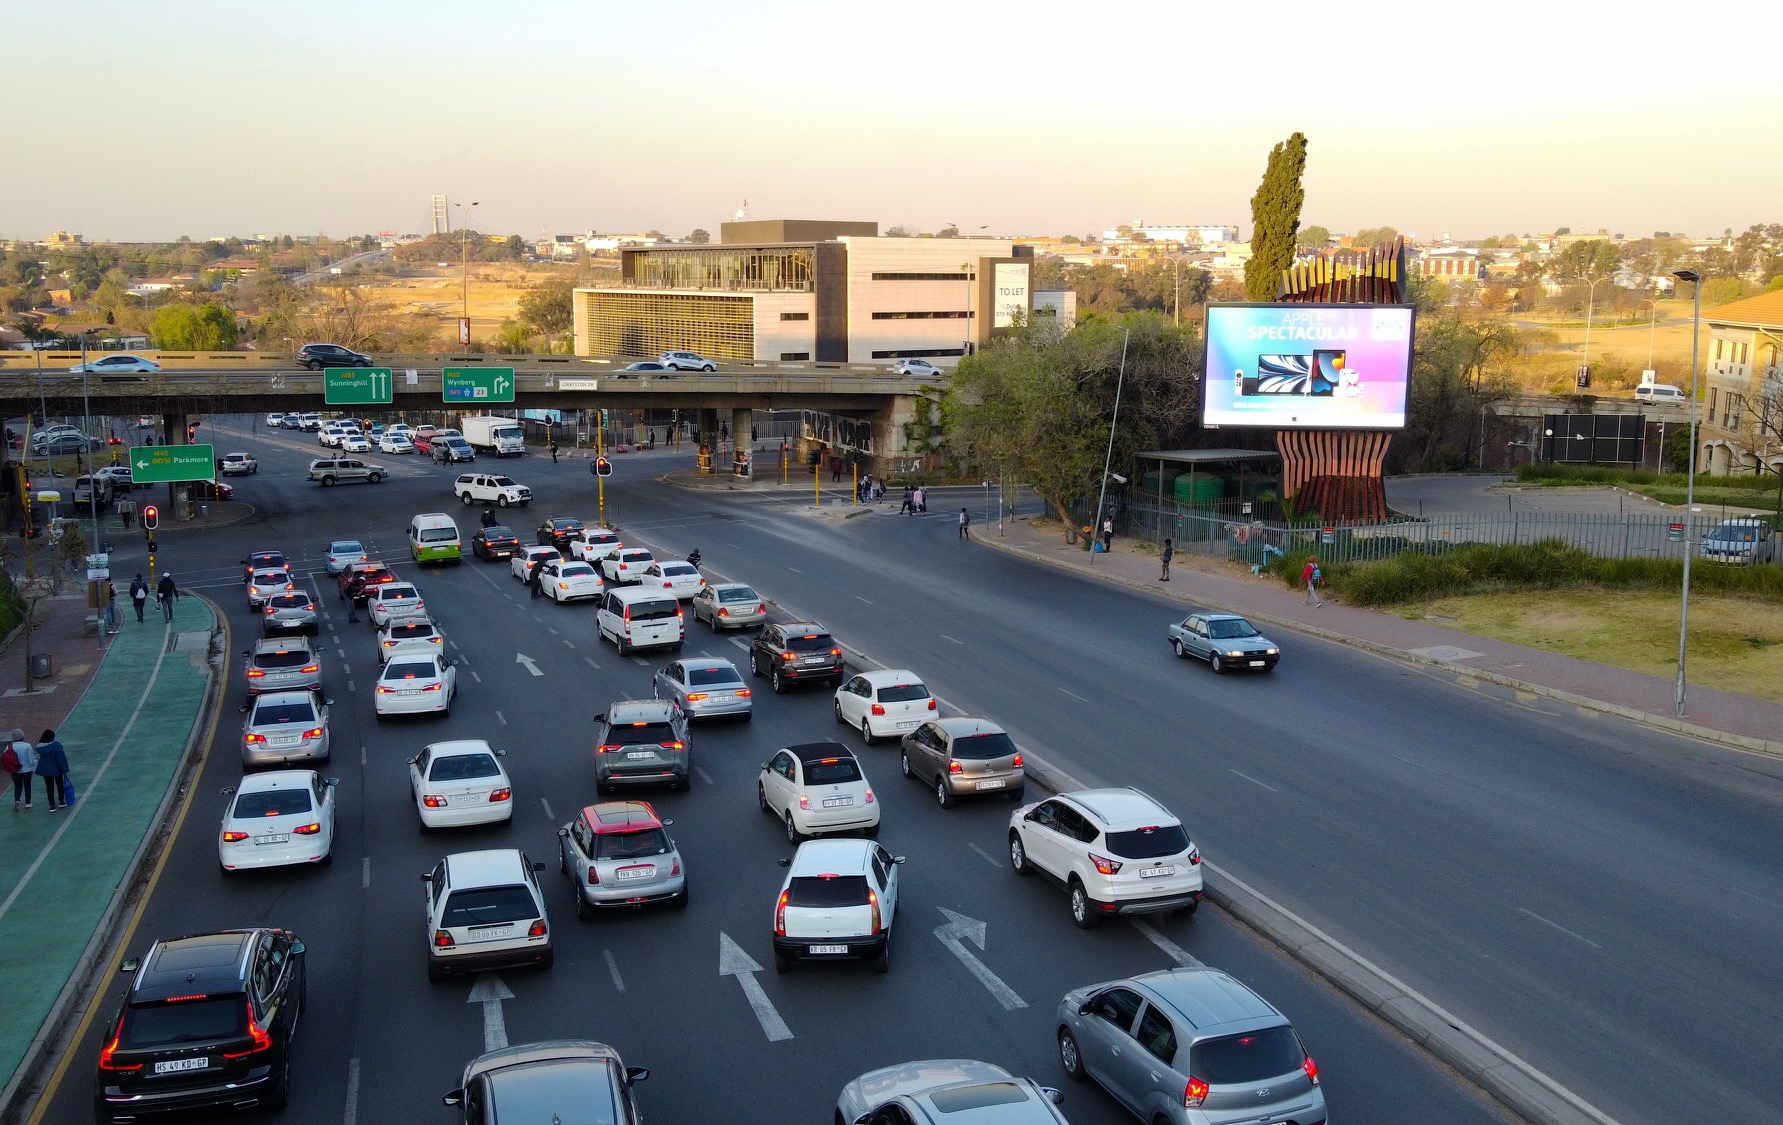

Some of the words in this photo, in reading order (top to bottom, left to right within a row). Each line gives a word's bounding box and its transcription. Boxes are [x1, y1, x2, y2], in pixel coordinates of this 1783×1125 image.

[999, 287, 1010, 296] TO
[1012, 287, 1025, 296] LET
[1282, 313, 1325, 326] APPLE
[1248, 326, 1358, 341] SPECTACULAR
[447, 379, 475, 387] Wynberg
[157, 1062, 167, 1071] HS
[170, 1060, 179, 1070] 49
[181, 1059, 192, 1069] KD
[197, 1058, 207, 1068] GP
